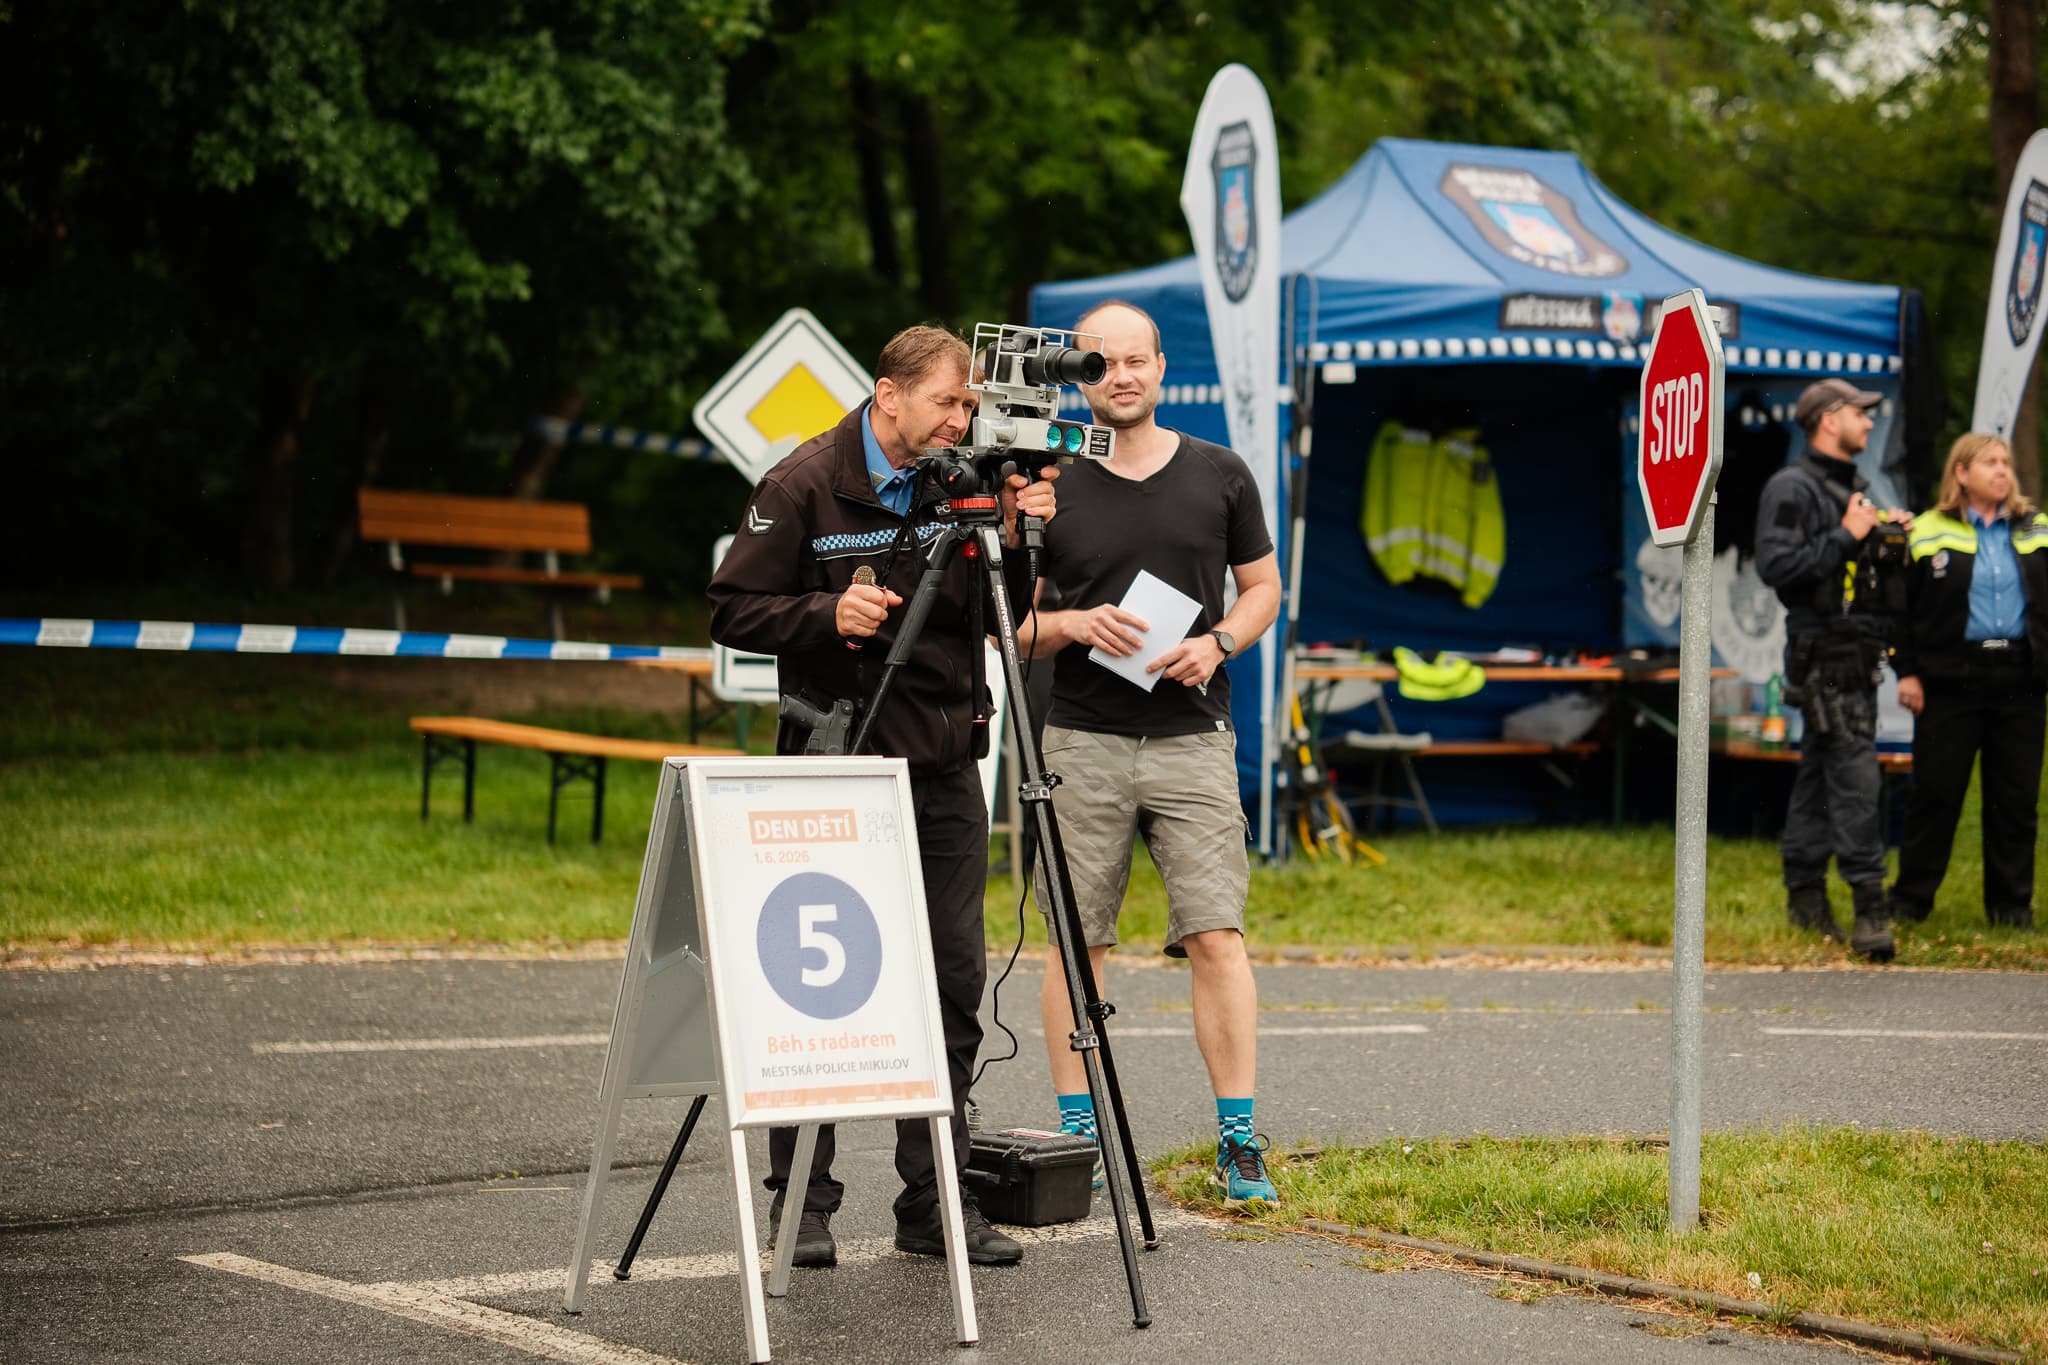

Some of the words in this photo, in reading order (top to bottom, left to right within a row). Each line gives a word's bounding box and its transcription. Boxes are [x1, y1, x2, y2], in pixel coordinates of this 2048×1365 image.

[1650, 372, 1704, 465] STOP
[996, 584, 1012, 637] Manfrotto
[754, 818, 799, 839] DEN
[803, 814, 852, 839] DĚTÍ
[798, 903, 847, 988] 5
[767, 1034, 804, 1054] Běh
[807, 1037, 817, 1052] s
[821, 1032, 897, 1051] radarem
[761, 1061, 814, 1078] MĚSTSKÁ
[815, 1061, 857, 1075] POLICIE
[859, 1057, 910, 1072] MIKULOV
